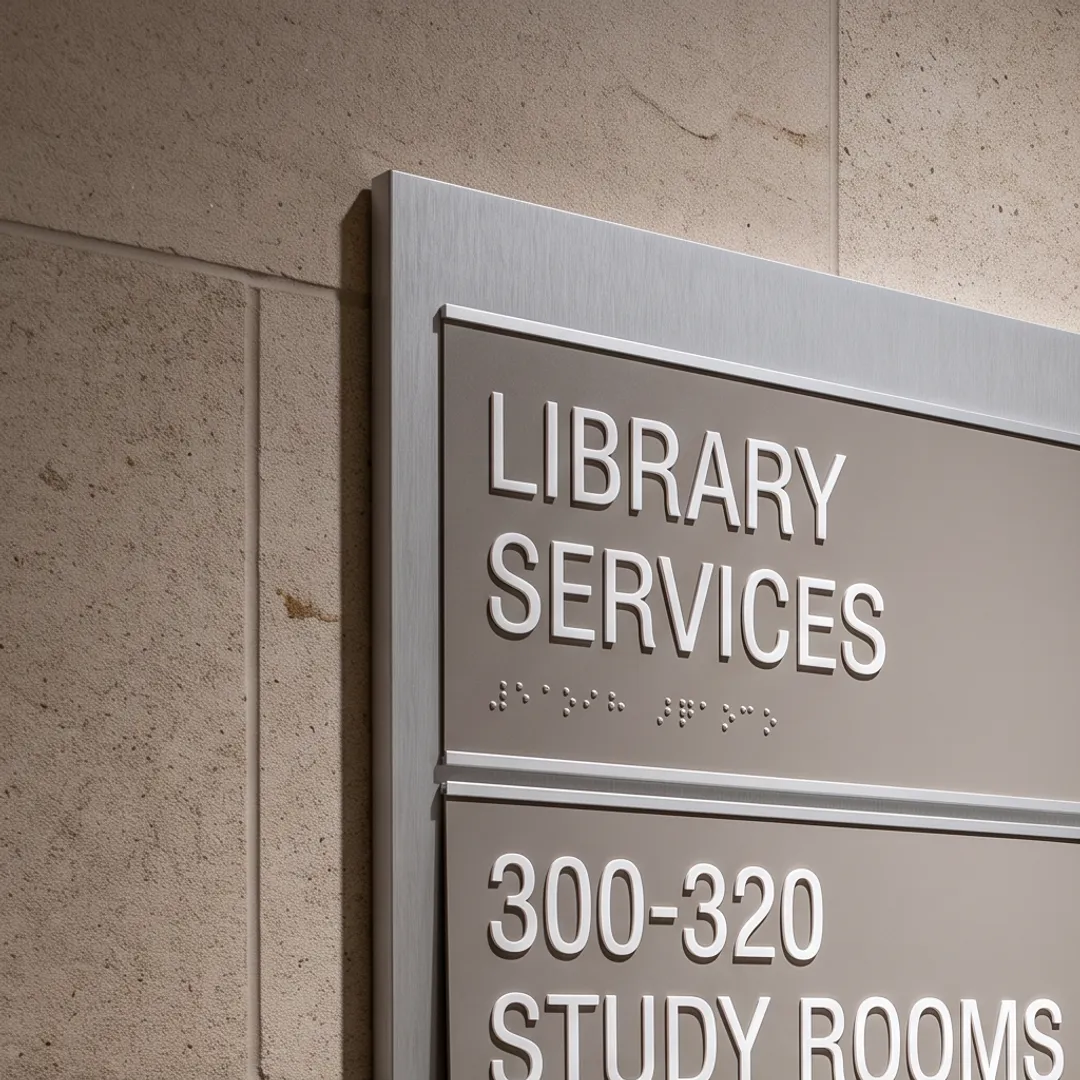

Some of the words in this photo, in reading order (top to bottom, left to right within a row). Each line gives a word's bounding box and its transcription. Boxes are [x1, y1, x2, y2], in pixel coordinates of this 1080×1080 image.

[490, 391, 847, 541] LIBRARY
[489, 532, 887, 676] SERVICES
[490, 853, 824, 962] 300-320
